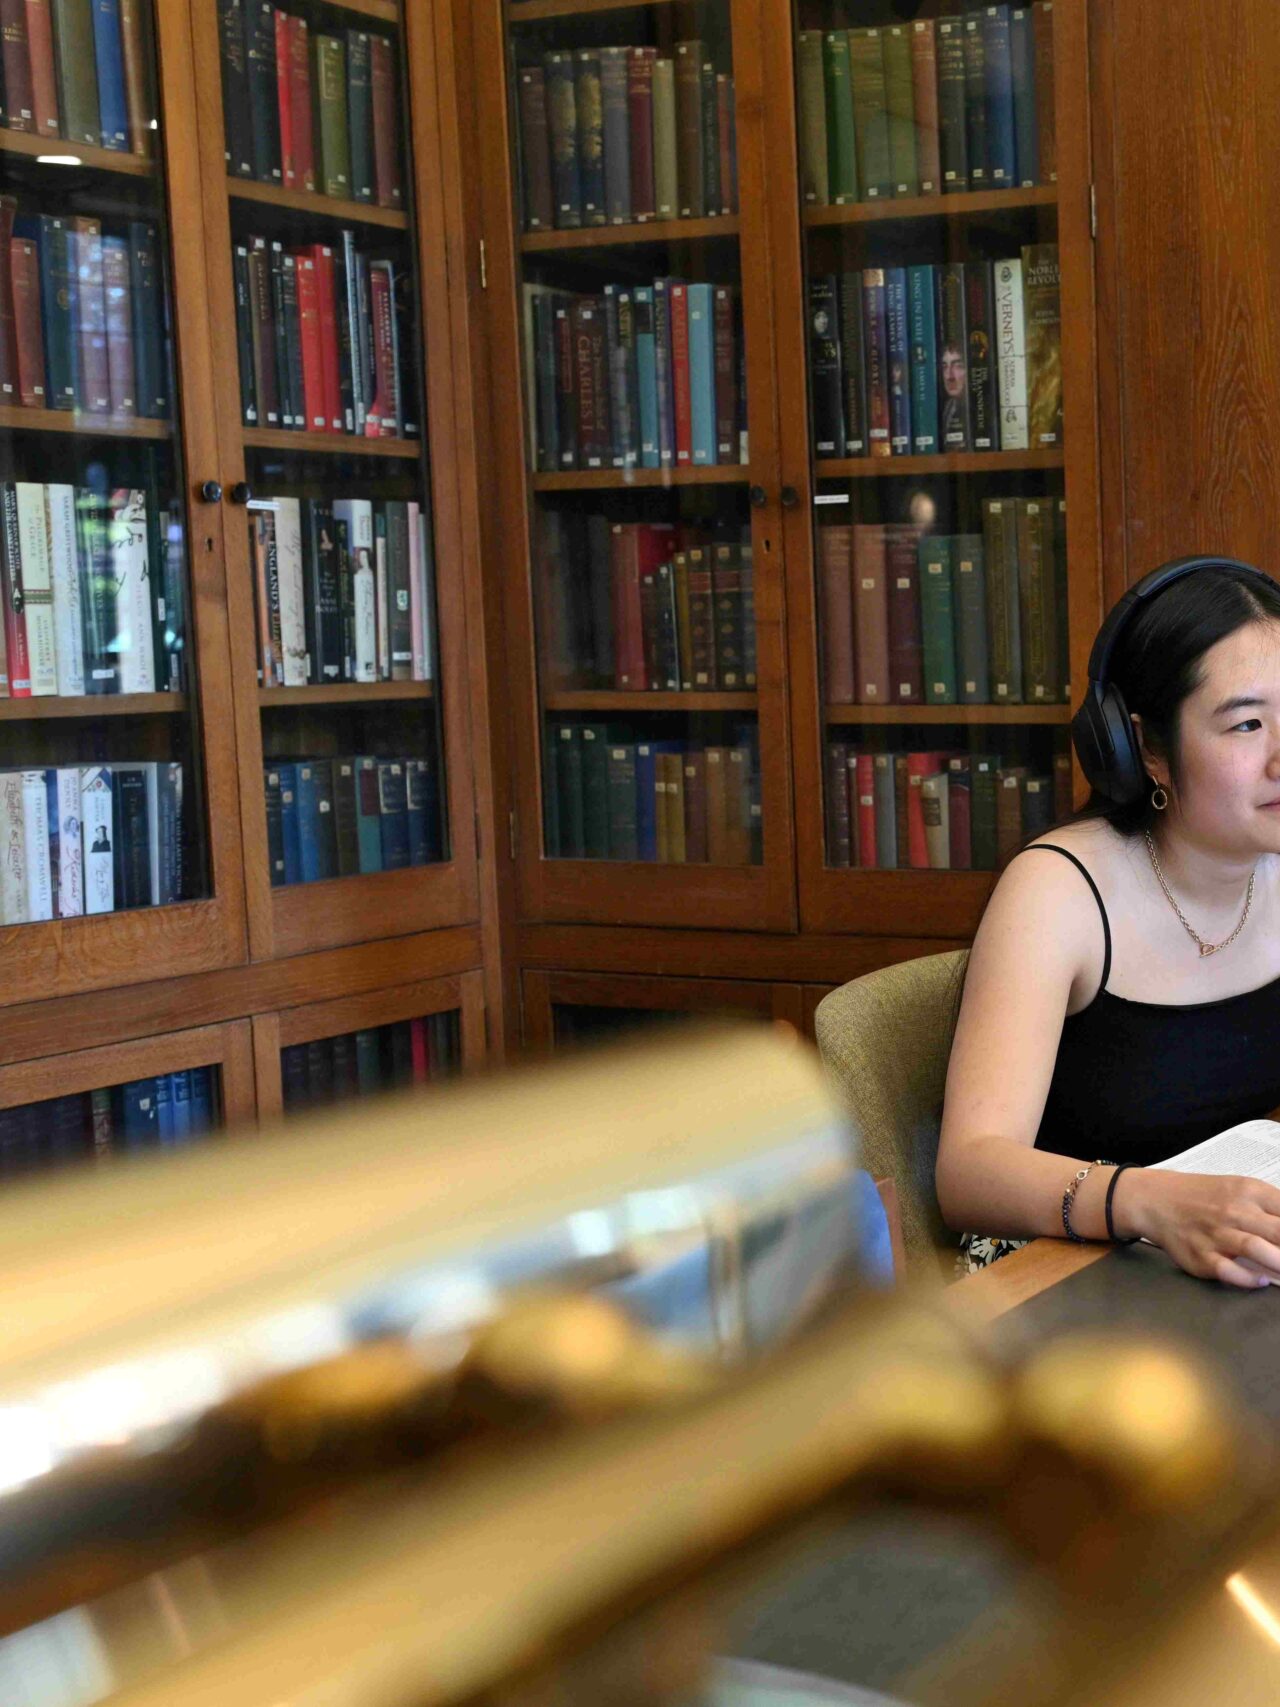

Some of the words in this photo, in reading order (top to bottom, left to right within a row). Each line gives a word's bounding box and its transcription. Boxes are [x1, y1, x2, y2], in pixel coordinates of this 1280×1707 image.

[914, 272, 922, 299] KING
[915, 301, 923, 314] IN
[1002, 292, 1015, 355] VERNEYS
[577, 335, 593, 418] CHARLES
[268, 540, 280, 611] ENGLAND'S
[34, 797, 44, 842] THOMAS
[37, 843, 48, 902] CROMWELL
